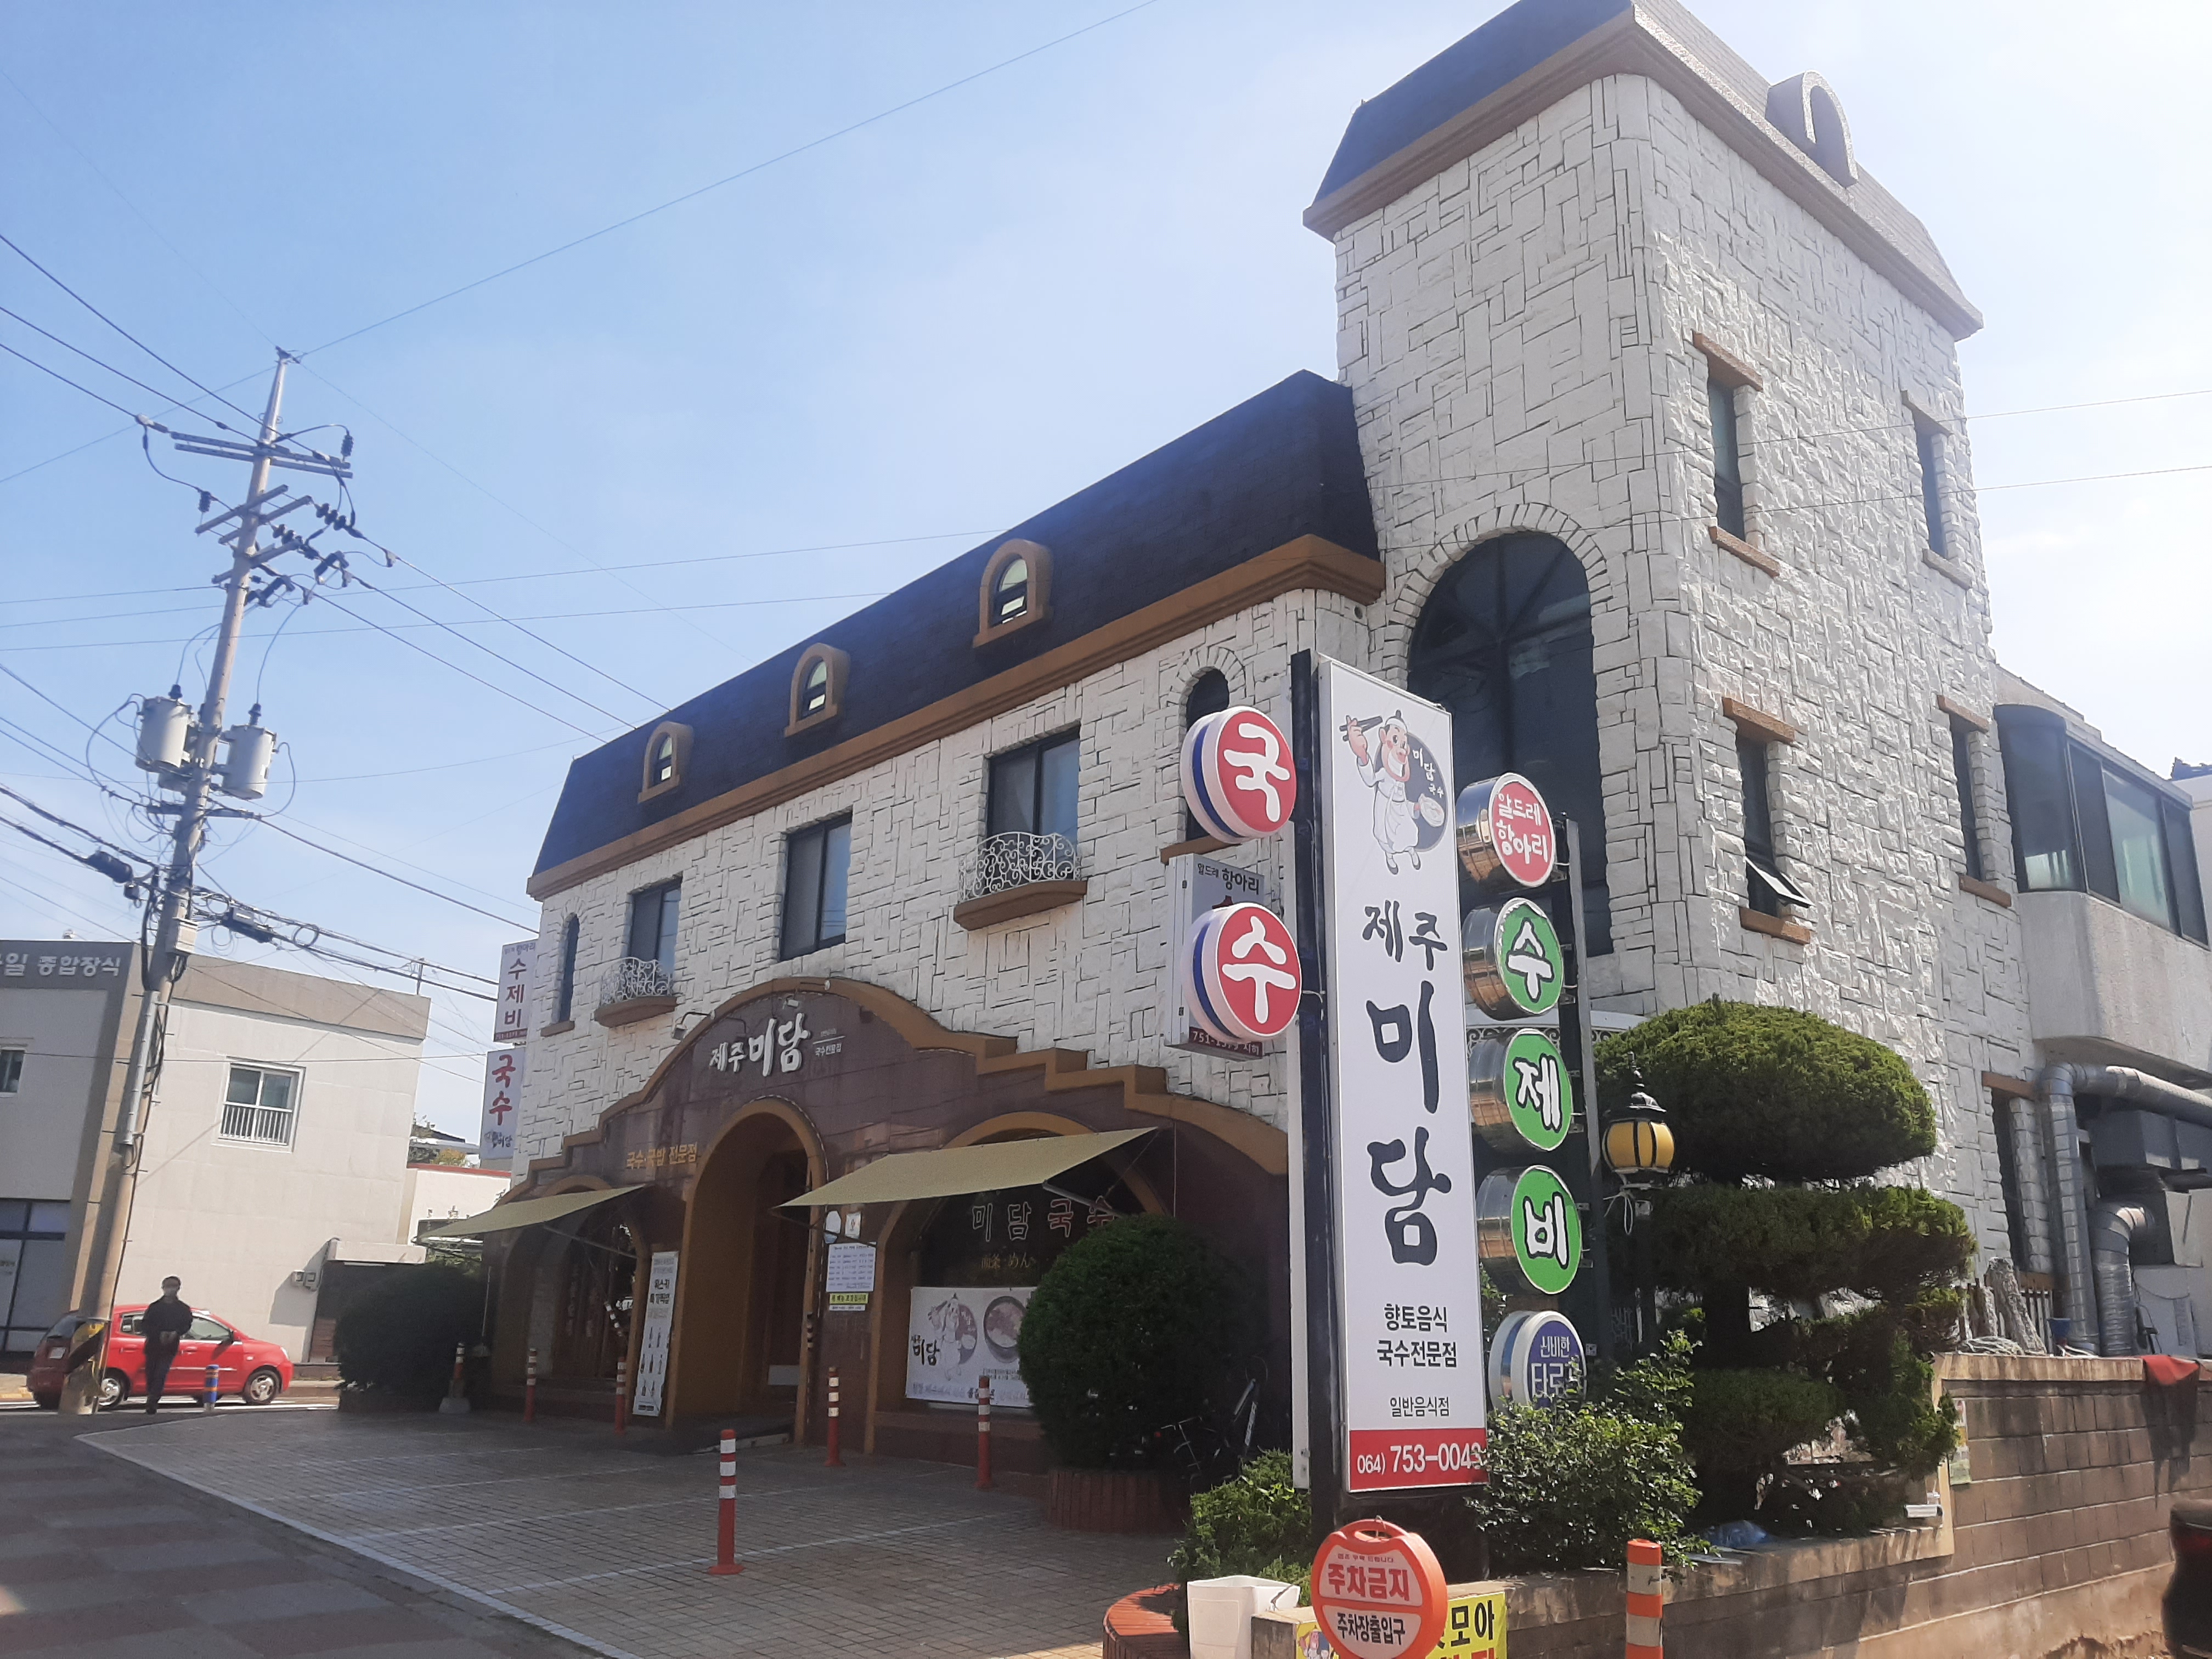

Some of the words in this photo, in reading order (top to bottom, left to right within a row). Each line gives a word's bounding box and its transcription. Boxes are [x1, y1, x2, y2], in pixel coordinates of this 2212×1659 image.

[1498, 793, 1542, 827] 알드레
[1497, 820, 1548, 865] 항아리
[1222, 867, 1259, 895] 항아리
[1362, 900, 1448, 971] 제주
[0, 953, 29, 977] 일
[37, 956, 121, 977] 종합장식
[488, 1054, 516, 1126] 국수
[669, 1141, 698, 1165] 전문점
[1384, 1304, 1447, 1333] 향토음식
[1377, 1340, 1457, 1367] 국수전문점
[1540, 1336, 1570, 1358] 신비한
[1390, 1397, 1449, 1417] 일반음식점
[1357, 1452, 1386, 1475] 064)
[1328, 1563, 1410, 1601] 주차금지
[1337, 1612, 1406, 1646] 주차장출입구
[1437, 1599, 1495, 1649] 모아
